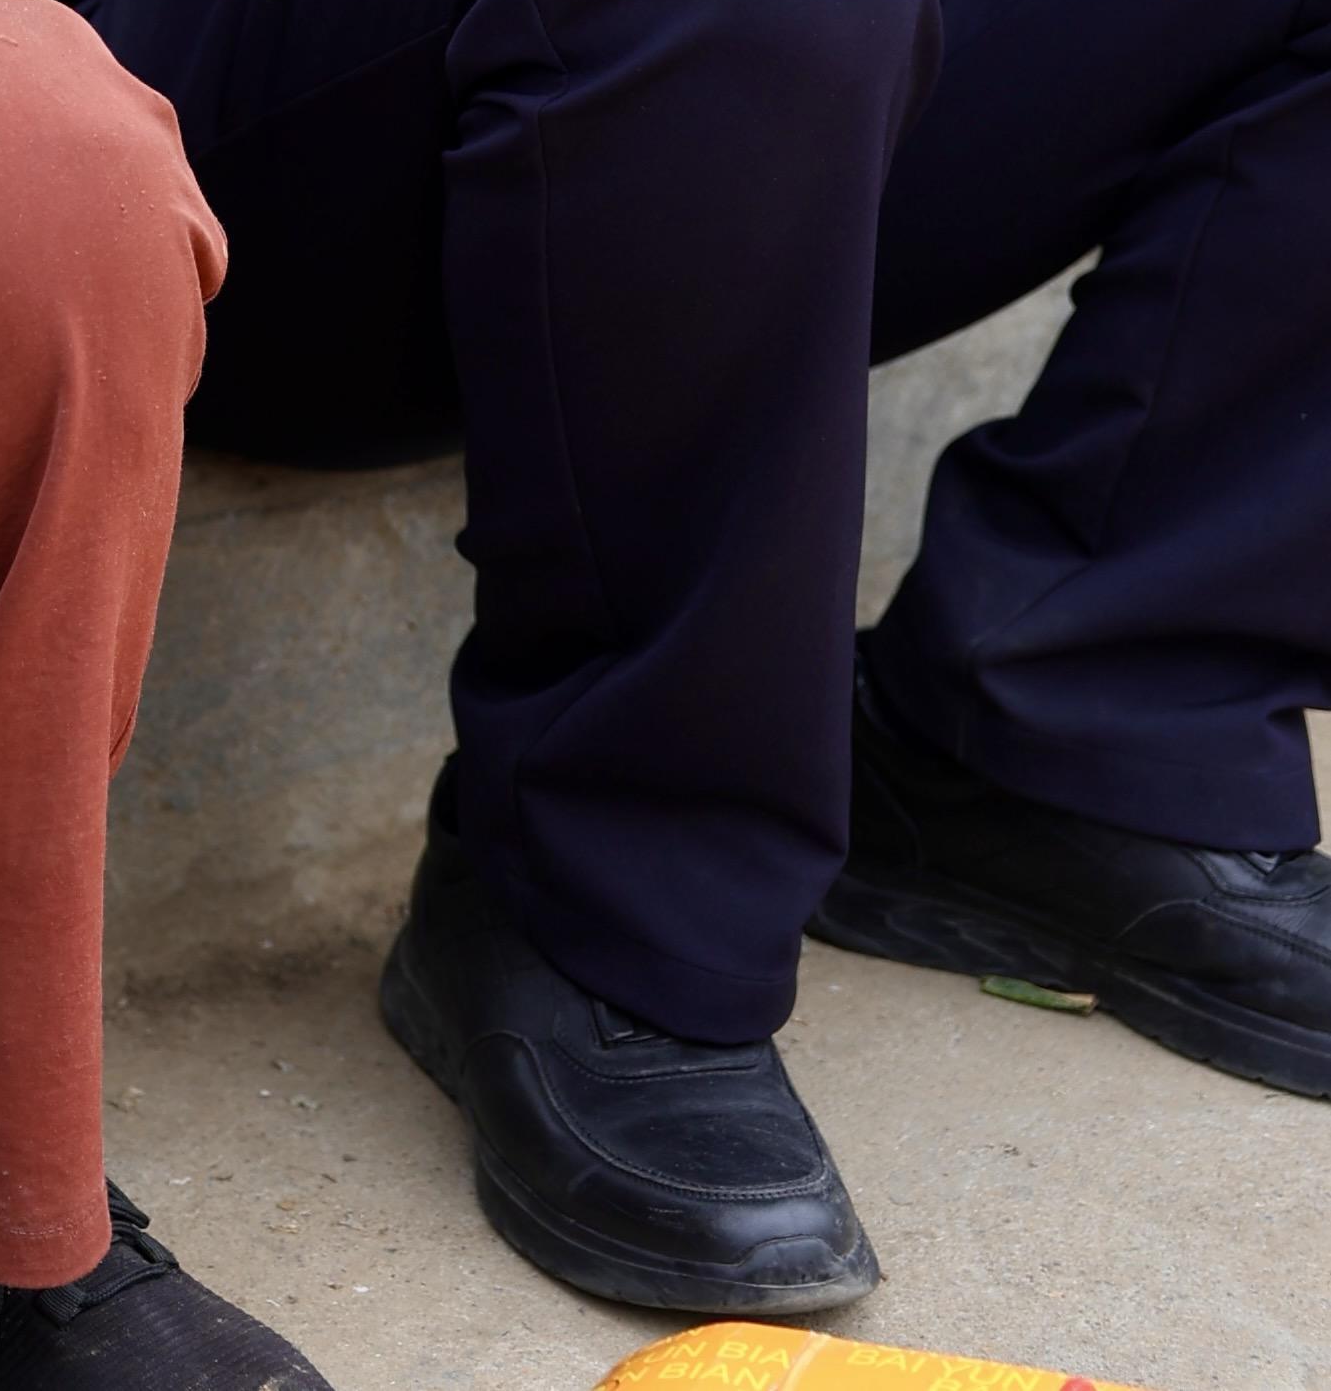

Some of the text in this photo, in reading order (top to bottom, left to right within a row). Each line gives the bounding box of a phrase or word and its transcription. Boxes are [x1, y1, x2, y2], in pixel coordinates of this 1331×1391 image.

[658, 1362, 772, 1391] BIAN
[846, 1348, 927, 1374] BAI
[939, 1359, 1042, 1391] YUN
